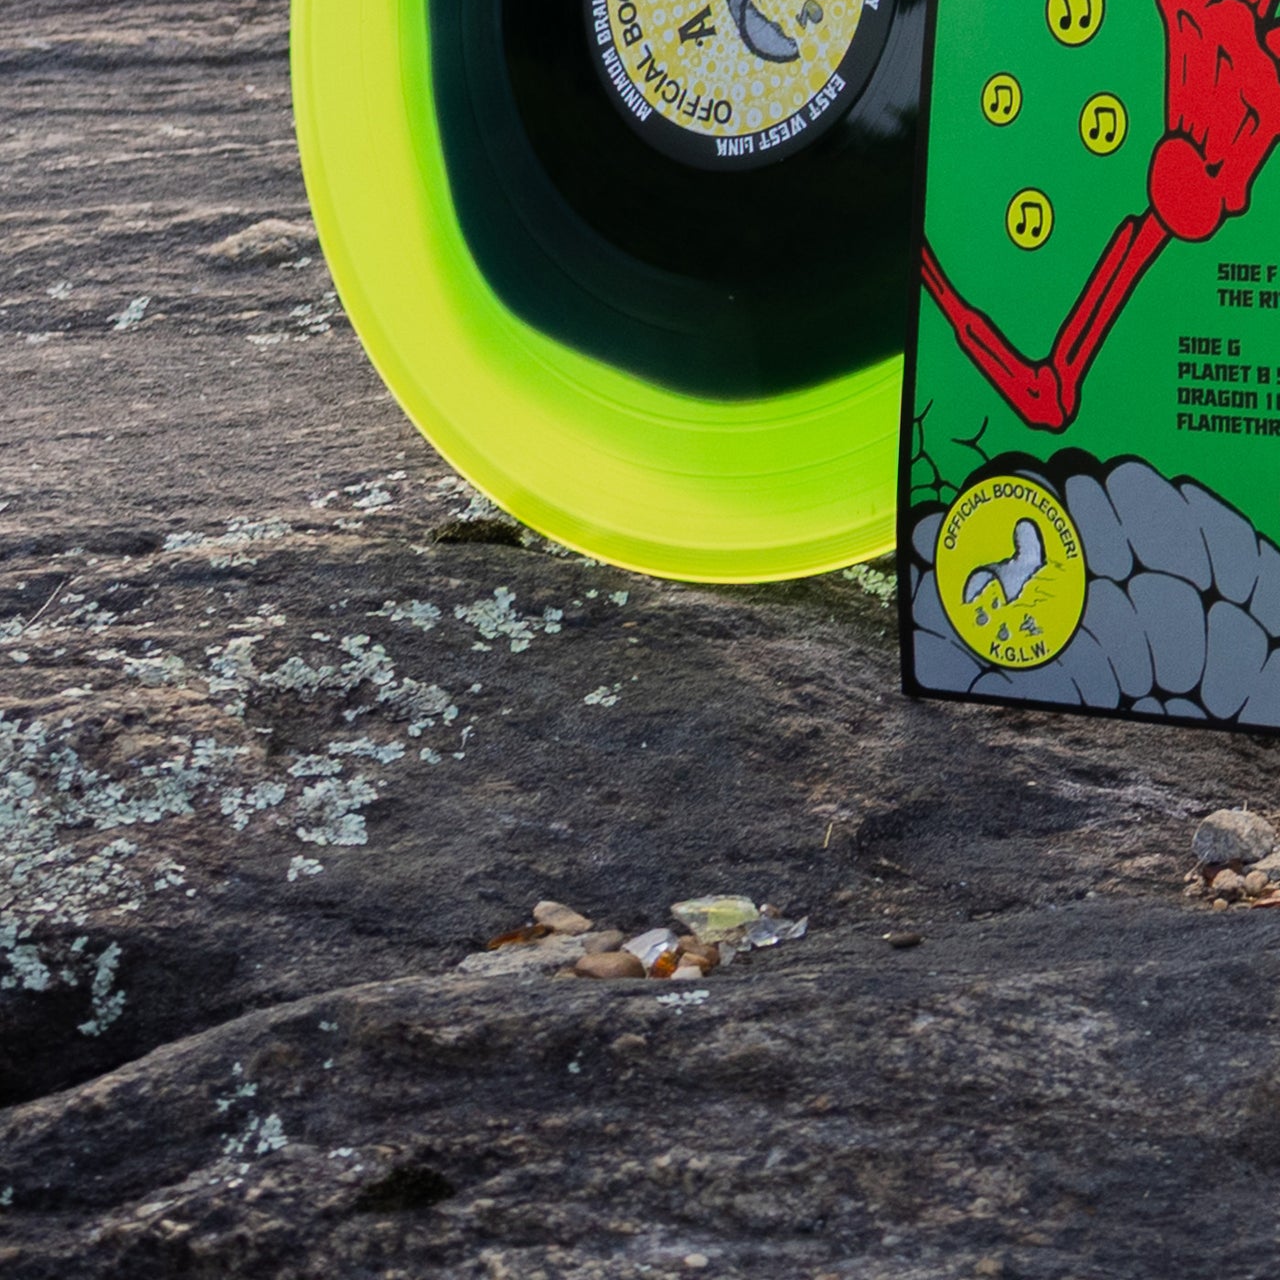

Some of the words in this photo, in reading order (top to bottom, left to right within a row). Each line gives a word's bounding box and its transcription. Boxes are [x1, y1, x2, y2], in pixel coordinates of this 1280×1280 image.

[1217, 263, 1261, 282] SIDE
[1266, 265, 1278, 282] F
[1218, 289, 1253, 308] THE
[1178, 337, 1222, 355] SIDE
[1228, 338, 1241, 356] G
[1178, 362, 1251, 383] PLANET
[1257, 366, 1270, 384] B
[1178, 388, 1258, 409] DRAGON
[944, 490, 991, 550] OFFICIAL
[993, 483, 1078, 560] BOOTLEGGER!
[989, 642, 1050, 662] K.G.L.W.
